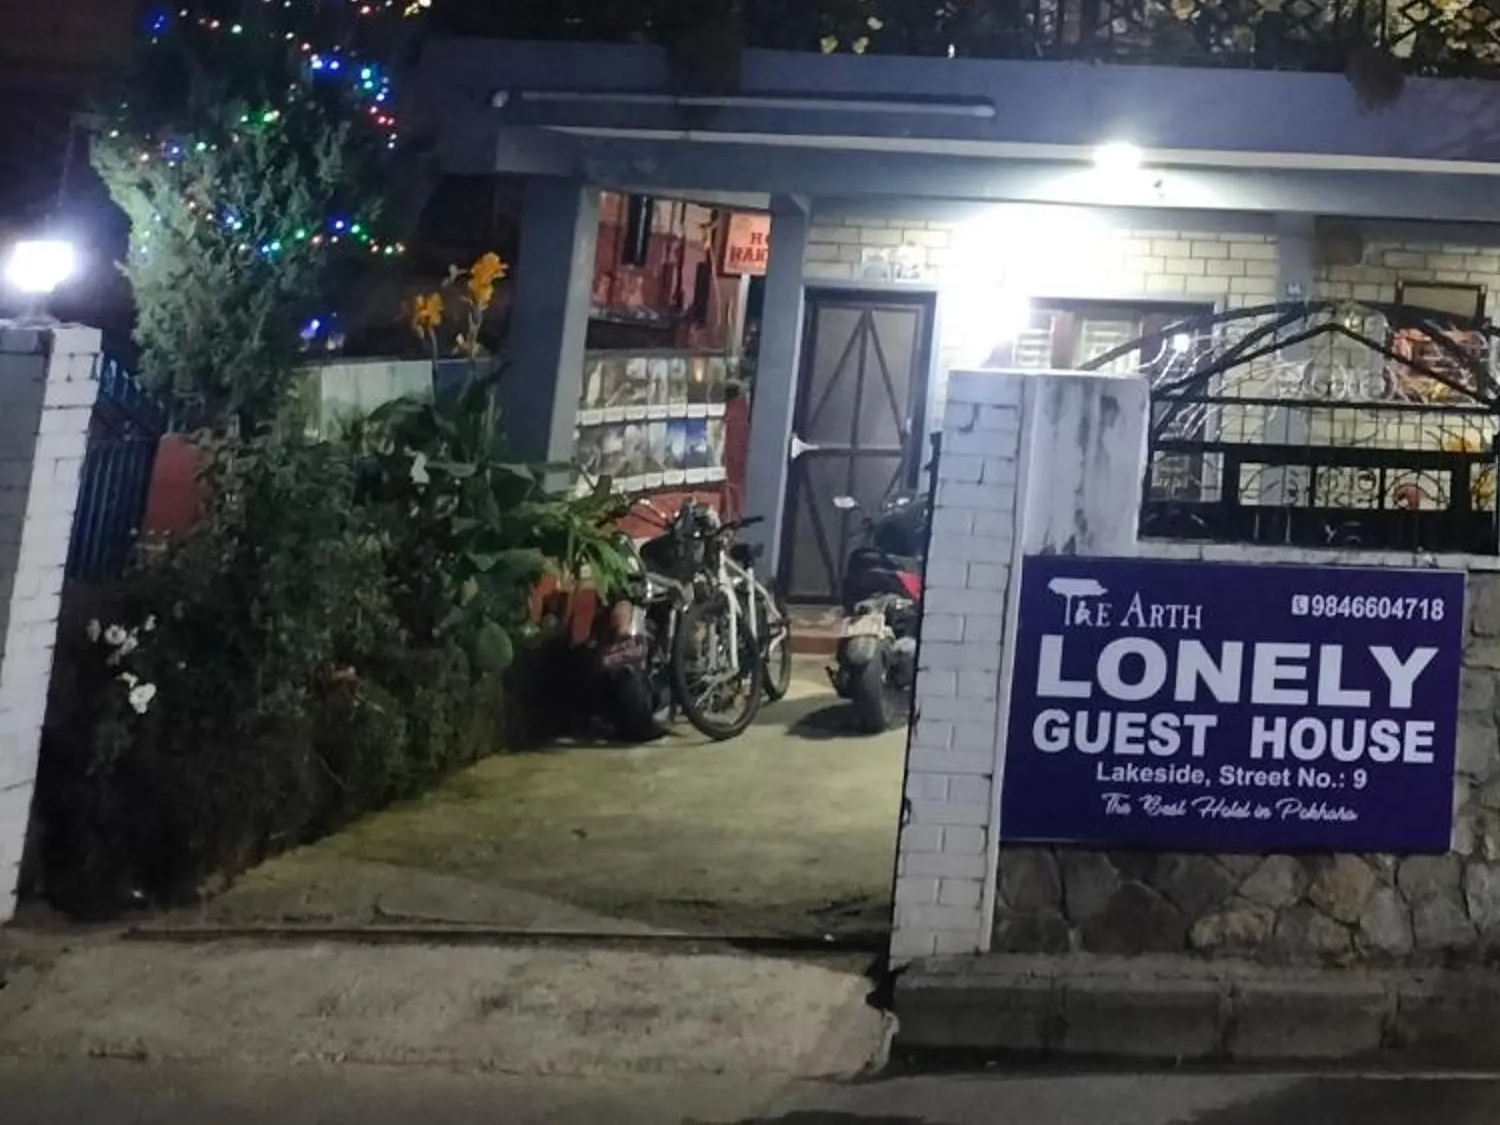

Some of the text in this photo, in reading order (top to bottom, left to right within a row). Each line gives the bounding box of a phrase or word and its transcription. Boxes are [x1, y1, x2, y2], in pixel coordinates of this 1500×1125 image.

[1312, 595, 1444, 620] 9846604718
[1037, 635, 1438, 708] LONELY
[1033, 709, 1434, 763] GUEST HOUSE
[1097, 762, 1210, 786] Lakeside,
[1220, 765, 1290, 786] Street
[1354, 769, 1367, 789] 9
[1102, 793, 1131, 814] The
[1254, 804, 1271, 819] in
